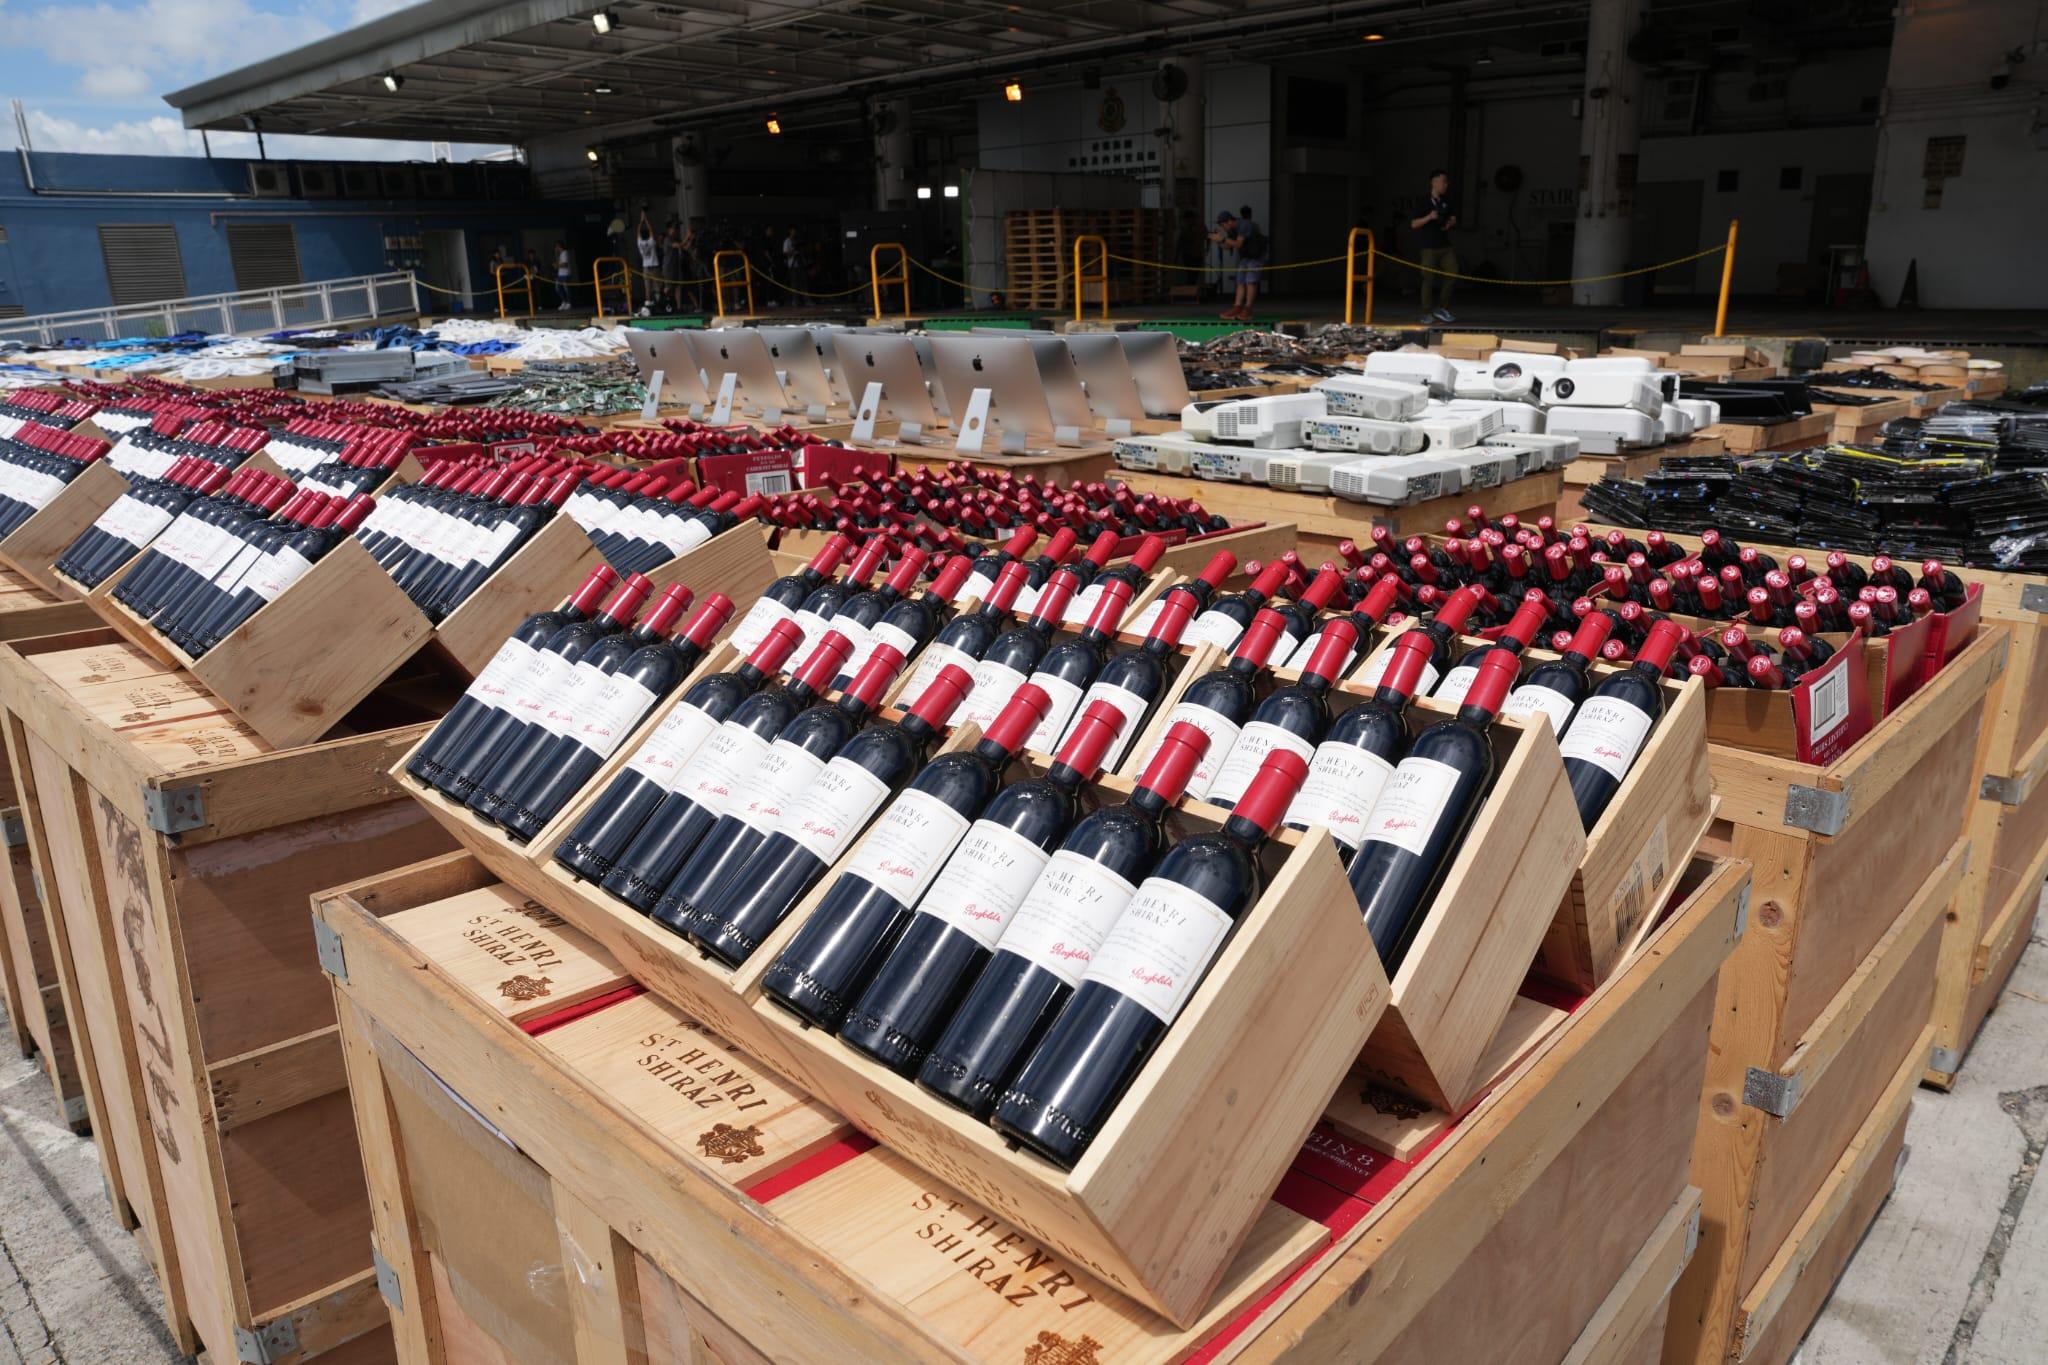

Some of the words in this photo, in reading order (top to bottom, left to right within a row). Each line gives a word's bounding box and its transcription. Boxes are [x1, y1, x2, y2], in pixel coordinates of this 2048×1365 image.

[1591, 707, 1625, 722] HENRI
[1326, 755, 1364, 778] HENRI
[1592, 745, 1623, 760] Penfolds
[1328, 809, 1361, 826] Penfolds
[974, 836, 1016, 869] HENRI
[1046, 880, 1088, 905] SHIRZ
[1058, 869, 1104, 905] HERI
[963, 903, 1002, 924] Penfolds
[1128, 906, 1169, 929] SHIRAZ
[1141, 896, 1188, 927] HENRI
[461, 928, 526, 968] SHIRAZ
[498, 925, 563, 969] HENRI
[1050, 941, 1091, 962] Penfolds
[1131, 967, 1174, 989] Penfolds
[635, 1053, 725, 1110] SHIRAZ
[676, 1046, 768, 1113] HENRI
[1309, 1131, 1353, 1156] BIN
[1356, 1153, 1375, 1167] 8
[915, 1221, 1039, 1308] SHIRAZ
[963, 1214, 1095, 1313] HENRI
